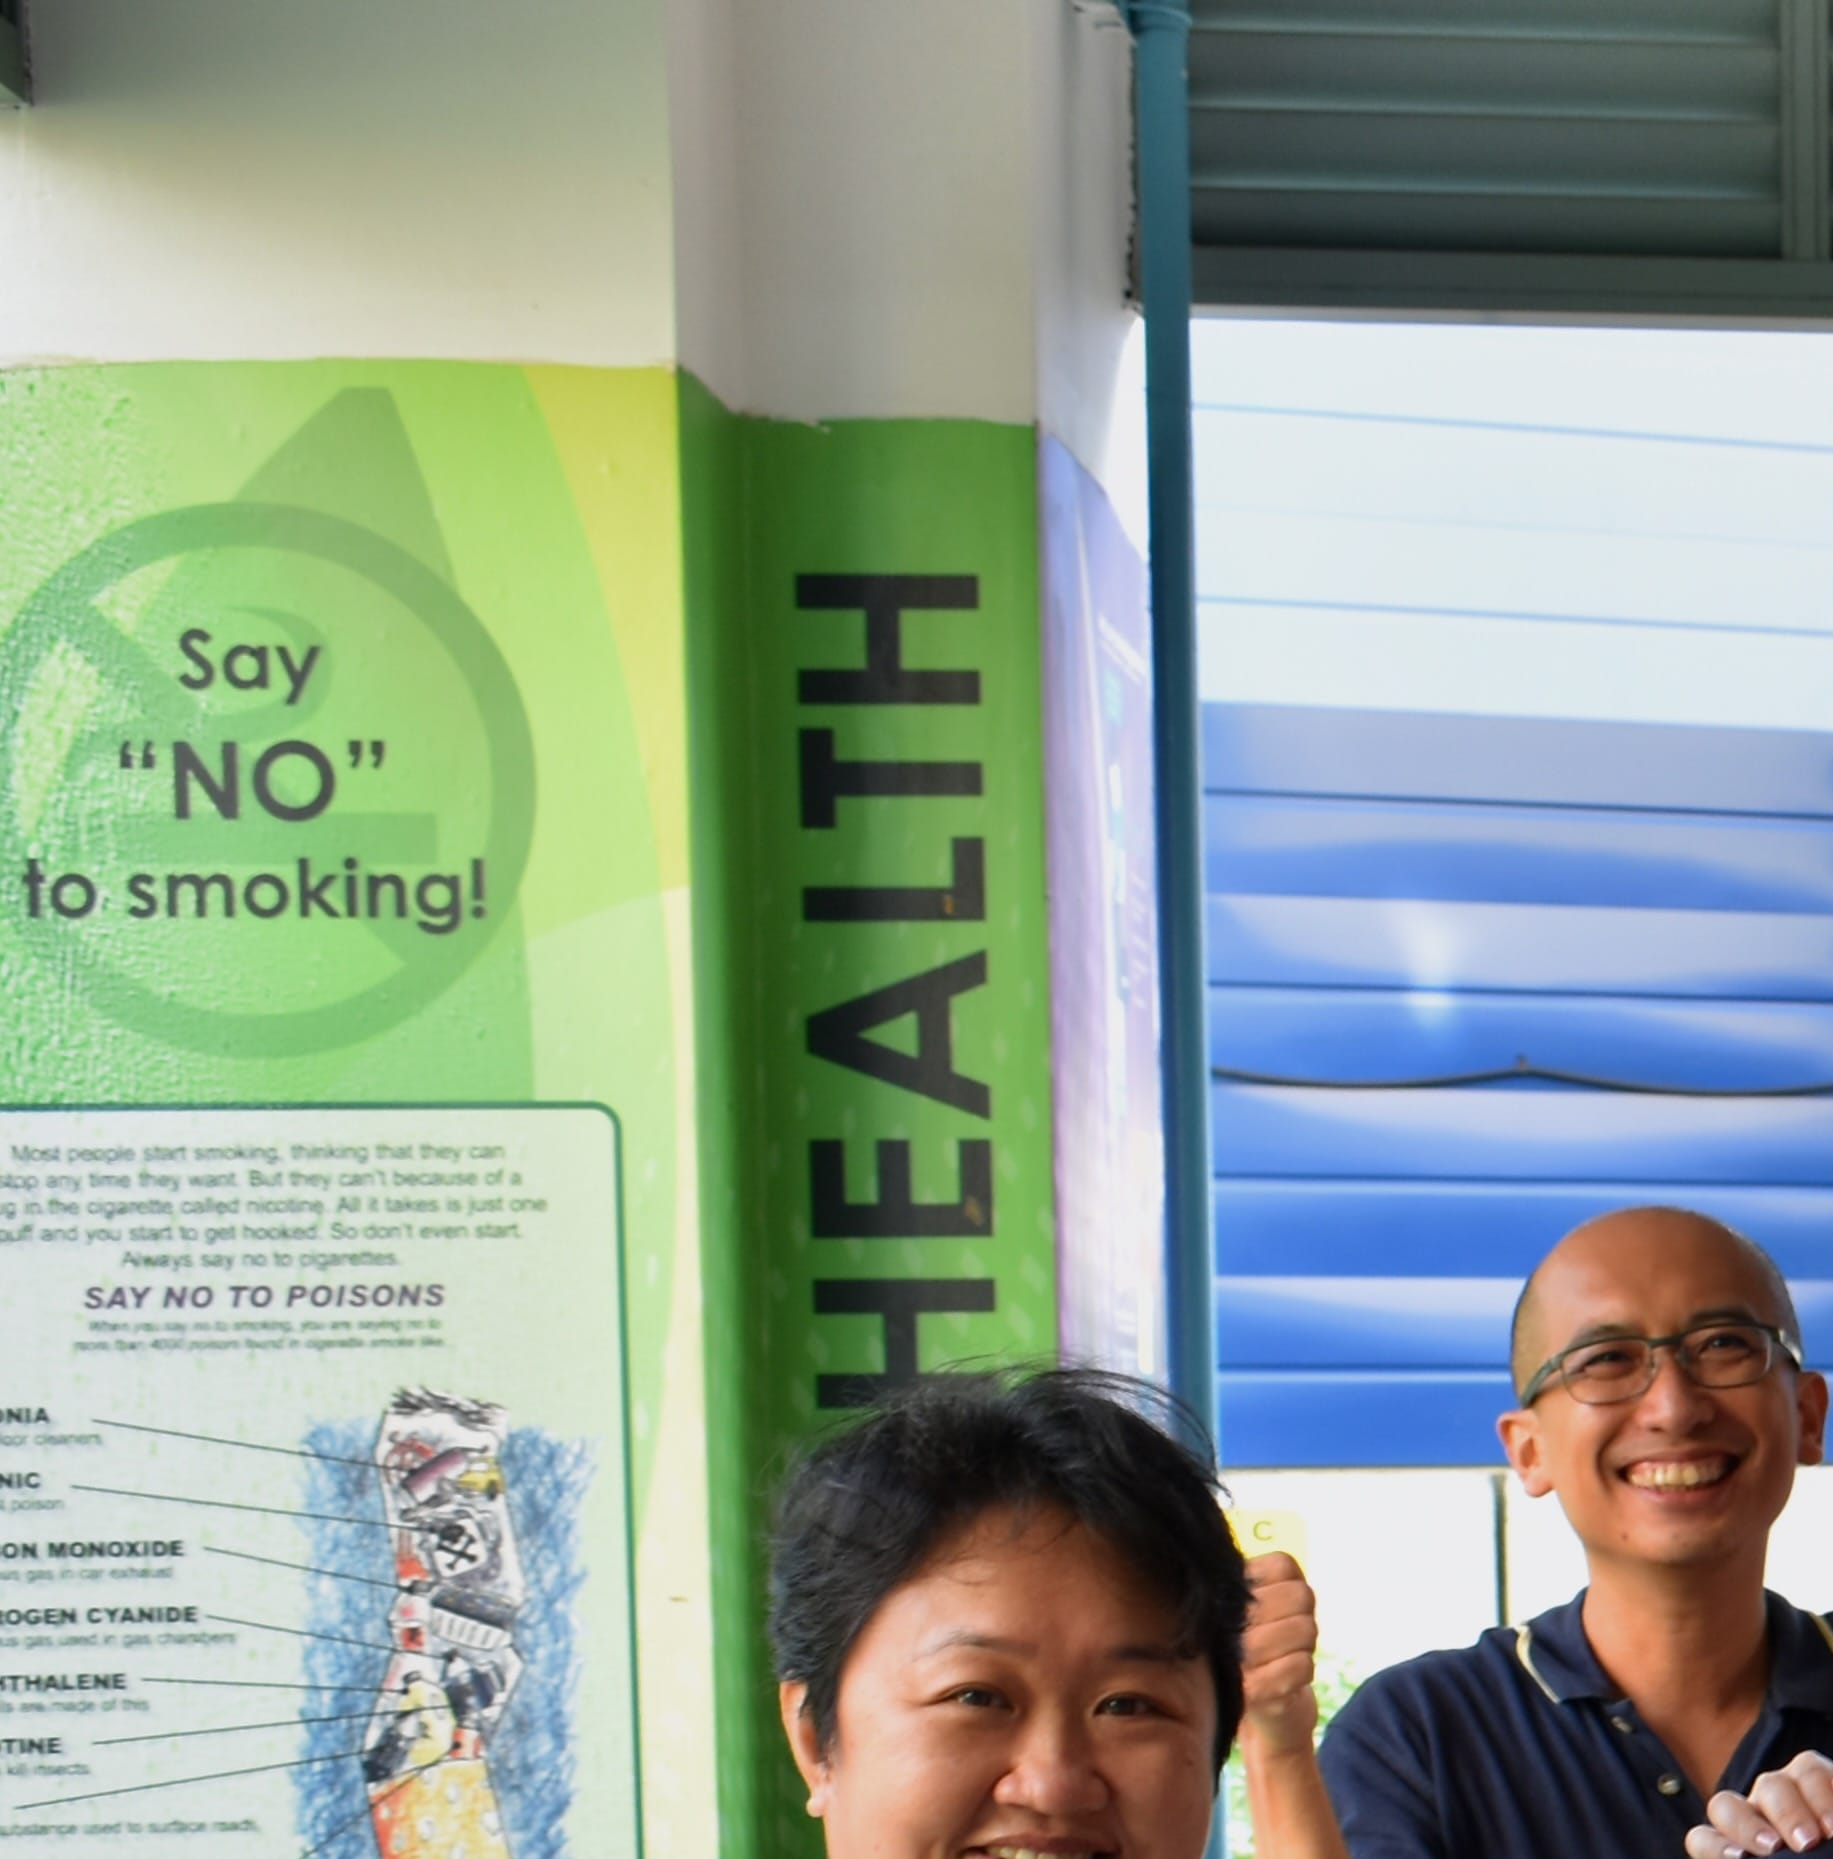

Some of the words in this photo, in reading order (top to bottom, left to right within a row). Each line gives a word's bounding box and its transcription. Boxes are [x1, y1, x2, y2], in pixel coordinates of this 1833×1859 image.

[178, 627, 322, 705] Say
[22, 857, 98, 919] to
[127, 856, 488, 937] smoking!
[794, 573, 996, 1410] HEALTH
[11, 1144, 61, 1161] Most
[67, 1146, 136, 1164] people
[144, 1145, 187, 1161] start
[195, 1145, 280, 1164] smoking,
[290, 1144, 368, 1164] thinking
[376, 1143, 413, 1160] that
[419, 1143, 461, 1163] they
[468, 1144, 506, 1160] can
[46, 1175, 82, 1192] any
[89, 1172, 131, 1188] time
[139, 1170, 181, 1192] they
[248, 1170, 284, 1187] But
[289, 1171, 332, 1190] they
[393, 1171, 478, 1186] because
[483, 1168, 505, 1187] of
[509, 1172, 523, 1186] a
[24, 1201, 43, 1214] in
[47, 1199, 81, 1214] the
[87, 1200, 174, 1219] cigarette
[181, 1198, 240, 1214] called
[336, 1196, 362, 1213] All
[366, 1198, 380, 1213] it
[384, 1197, 440, 1213] takes
[445, 1198, 463, 1213] is
[467, 1197, 504, 1216] just
[510, 1199, 549, 1213] one
[40, 1226, 79, 1242] and
[86, 1228, 122, 1246] you
[129, 1225, 173, 1241] start
[180, 1225, 199, 1241] to
[205, 1225, 237, 1245] get
[330, 1222, 358, 1240] So
[419, 1224, 469, 1239] even
[122, 1251, 193, 1271] Always
[200, 1253, 235, 1271] say
[242, 1253, 269, 1267] no
[273, 1252, 293, 1267] to
[84, 1286, 152, 1310] SAY
[163, 1286, 215, 1309] NO
[229, 1285, 273, 1309] TO
[286, 1283, 446, 1308] POISONS
[0, 1407, 51, 1424] NIA
[0, 1472, 42, 1489] NIC
[48, 1540, 186, 1559] MONOXIDE
[0, 1609, 78, 1626] OGEN
[87, 1606, 199, 1625] CYANIDE
[0, 1673, 128, 1692] THALENE
[0, 1737, 64, 1755] TINE
[0, 1822, 79, 1837] ubstance
